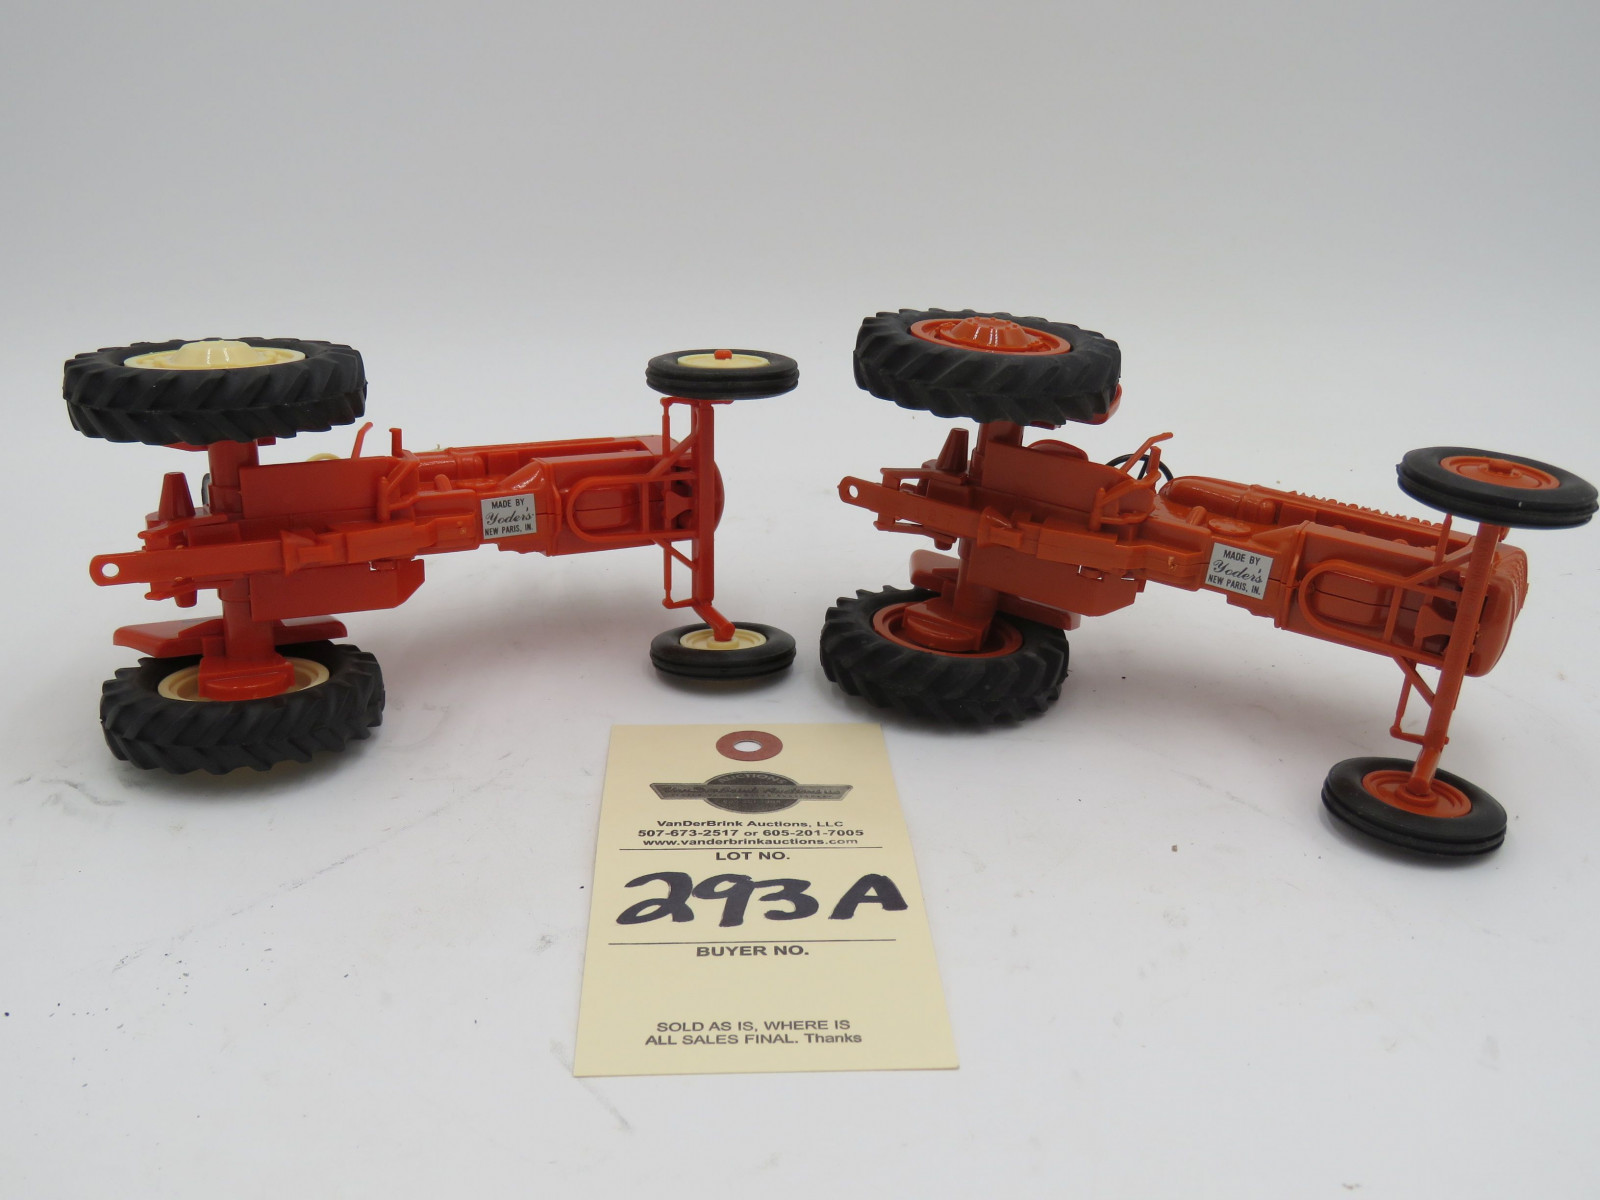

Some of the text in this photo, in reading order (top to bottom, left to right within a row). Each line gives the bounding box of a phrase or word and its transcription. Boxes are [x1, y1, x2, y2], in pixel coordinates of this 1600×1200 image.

[491, 498, 525, 509] MADE BY
[484, 527, 499, 536] NEW
[1223, 549, 1261, 566] MADE BY
[1213, 559, 1263, 583] Yoder's
[1208, 574, 1224, 586] NEW
[1226, 578, 1248, 592] PARIS,
[657, 820, 743, 828] VanDerBrink
[817, 820, 844, 828] LLC
[638, 829, 739, 837] 507-673-2517
[762, 829, 864, 837] 605-201-7005
[643, 837, 858, 847] www.vanderbrinkauctions.com
[715, 851, 790, 861] LOT NO.
[696, 945, 809, 957] BUYER NO.
[656, 1020, 850, 1034] SOLD AS IS, WHERE IS
[645, 1033, 863, 1046] ALL SALES FINAL. Thanks
